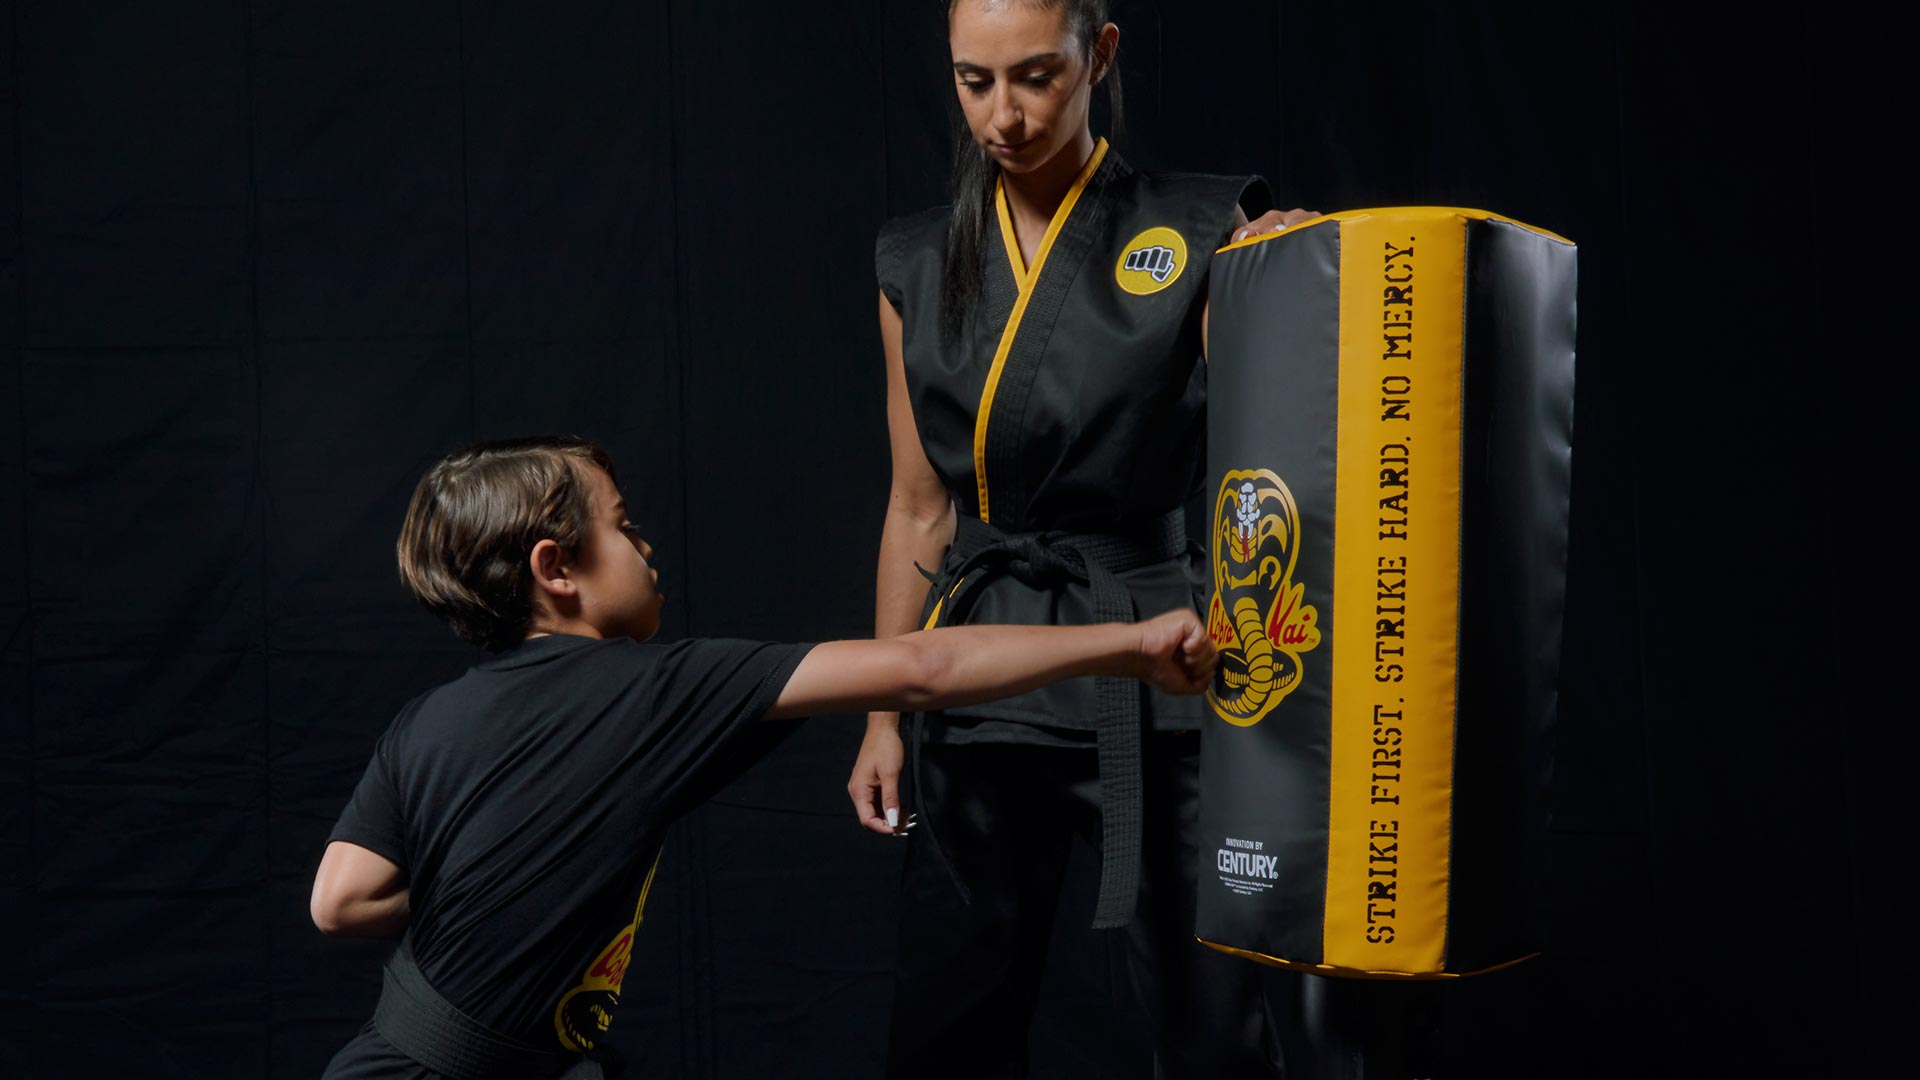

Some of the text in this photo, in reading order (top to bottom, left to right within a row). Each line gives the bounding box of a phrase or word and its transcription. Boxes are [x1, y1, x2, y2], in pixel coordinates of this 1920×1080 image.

[1366, 237, 1415, 944] STRIKE FIRST. STRIKE HARD. NO MERCY.
[1209, 597, 1234, 645] Cobra
[1226, 837, 1264, 851] INNOVATION BY
